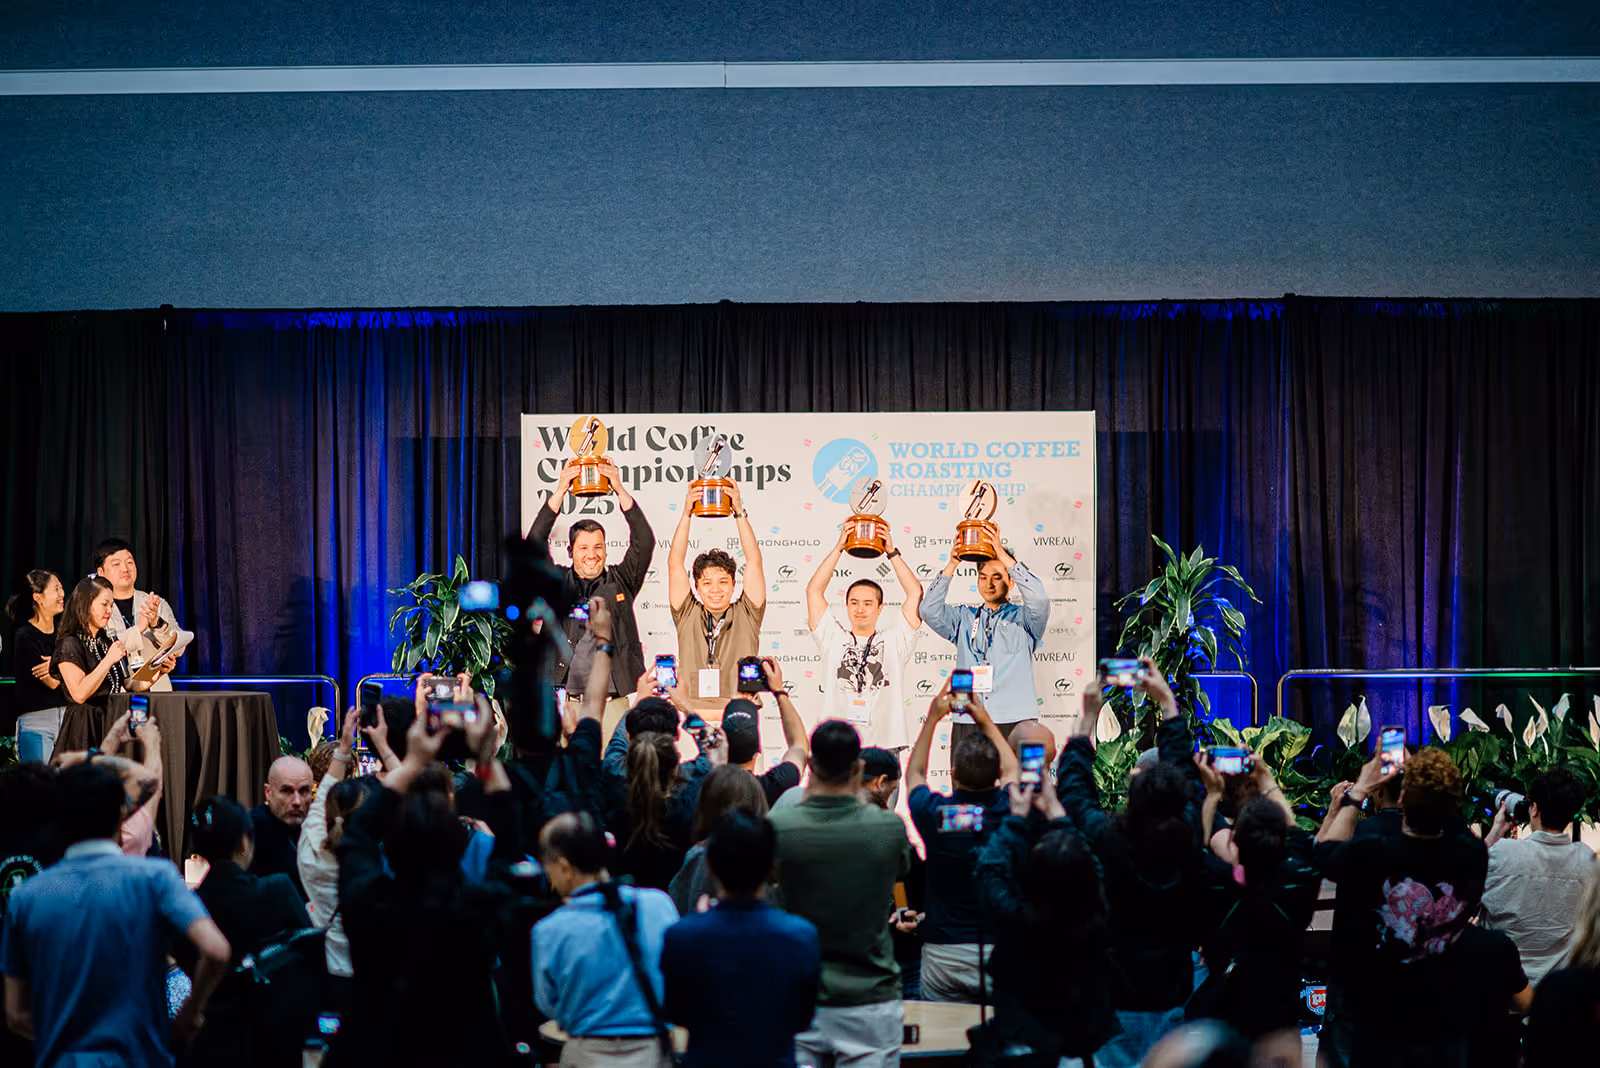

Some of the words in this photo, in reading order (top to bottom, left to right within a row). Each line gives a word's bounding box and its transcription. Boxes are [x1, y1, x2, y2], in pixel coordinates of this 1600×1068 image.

[537, 426, 636, 452] Wld
[646, 425, 745, 451] Coffe
[888, 442, 979, 459] WORLD
[986, 441, 1080, 458] COFFEE
[537, 457, 791, 490] Cpioips
[888, 462, 1012, 479] ROASTING
[890, 484, 1026, 497] CHAMPIHIP
[658, 540, 700, 549] VIVAU
[1033, 537, 1075, 546] VIVREAU
[1034, 652, 1075, 662] VIVREAU
